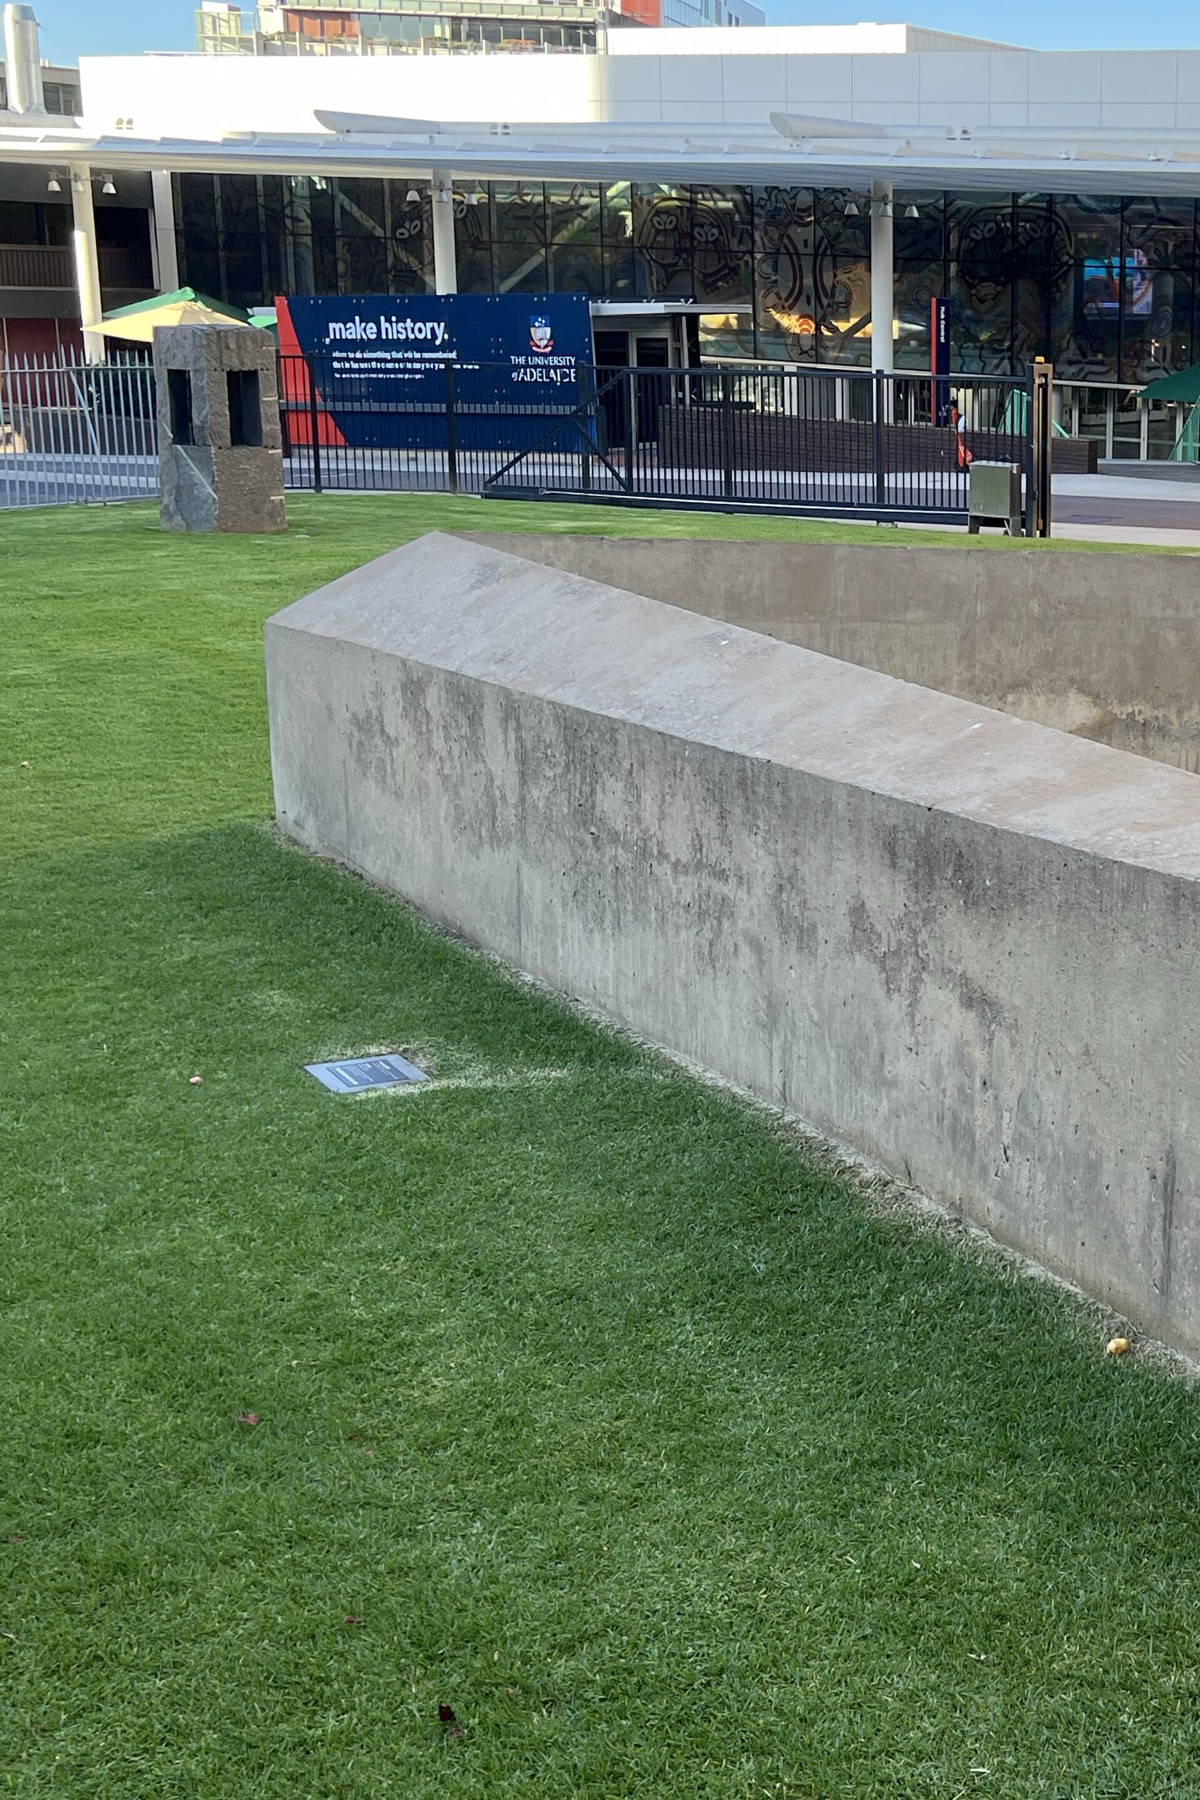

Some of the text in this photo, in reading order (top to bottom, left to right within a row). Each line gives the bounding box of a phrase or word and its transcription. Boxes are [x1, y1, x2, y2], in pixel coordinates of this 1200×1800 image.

[328, 316, 378, 340] make
[363, 350, 391, 360] something
[510, 355, 576, 366] THE UNIVERSITY
[518, 368, 577, 382] ADELAIDE
